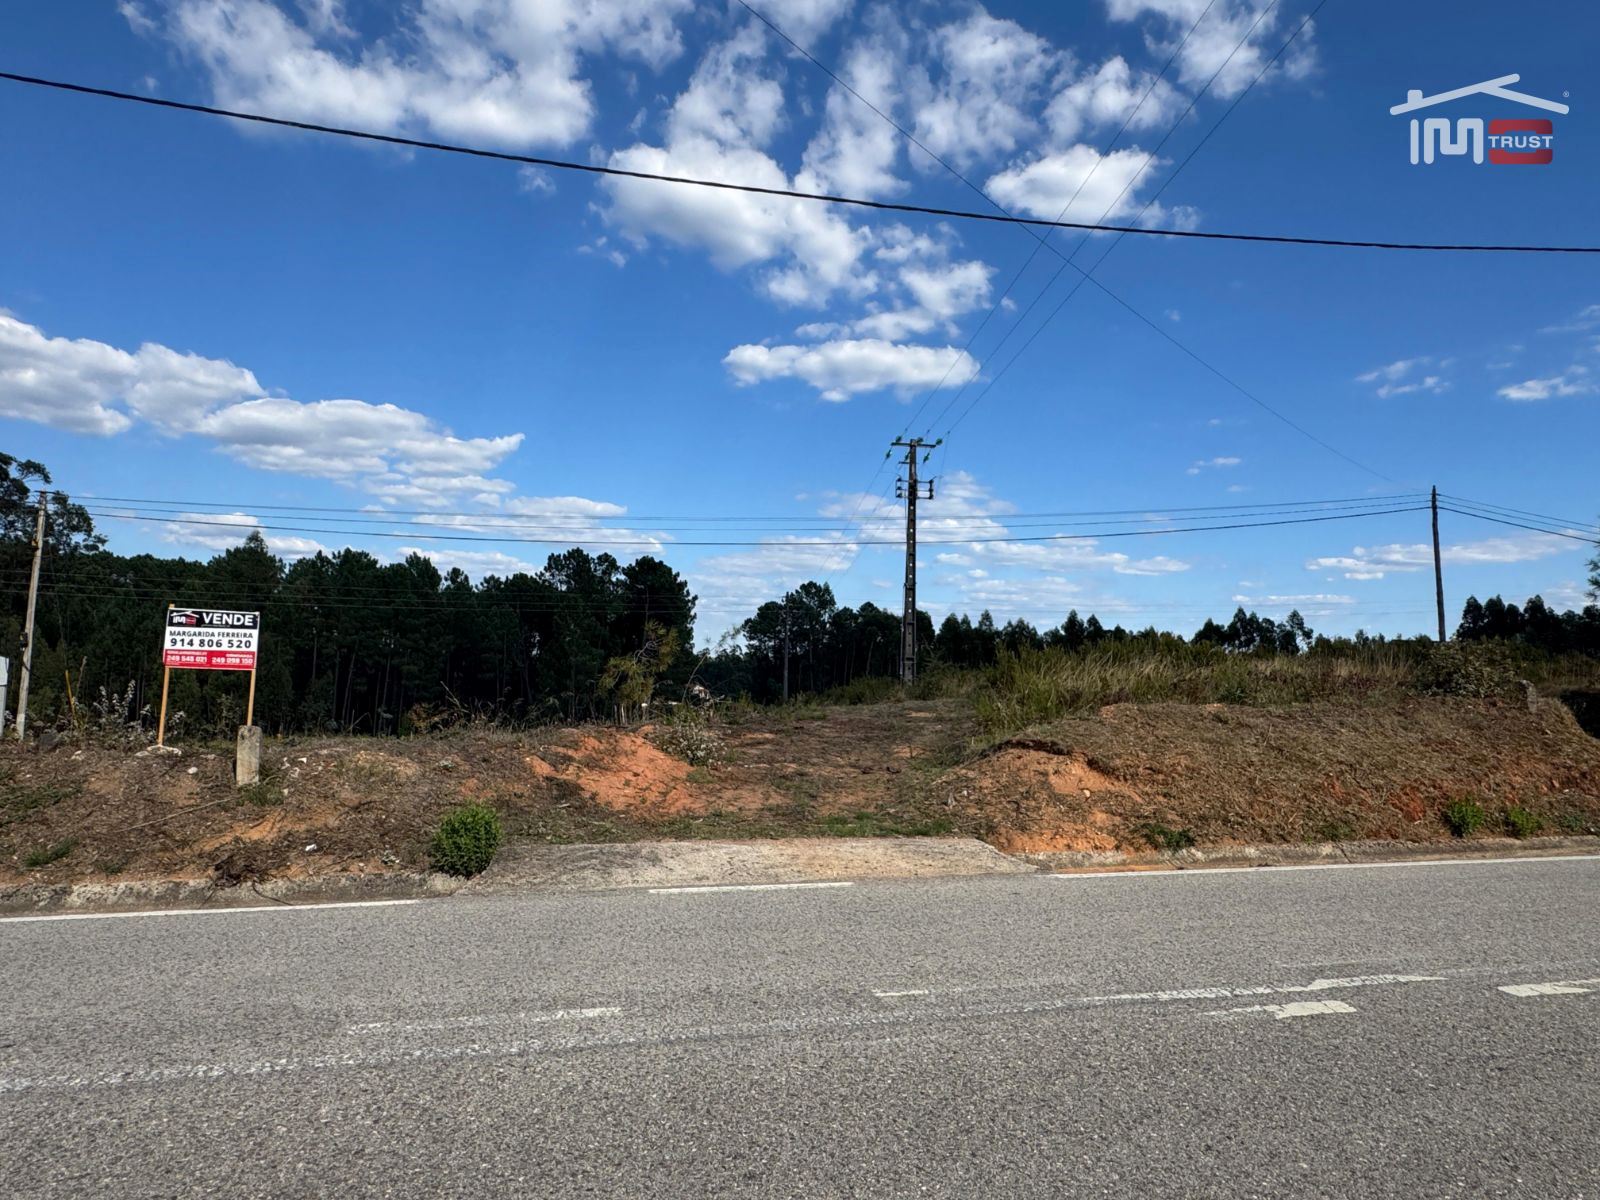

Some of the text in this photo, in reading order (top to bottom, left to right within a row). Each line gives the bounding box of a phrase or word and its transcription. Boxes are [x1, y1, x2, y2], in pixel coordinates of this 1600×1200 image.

[202, 612, 254, 626] VENDE
[169, 630, 253, 639] MARGARIDA FERREIRA
[170, 638, 252, 649] 914 806 520
